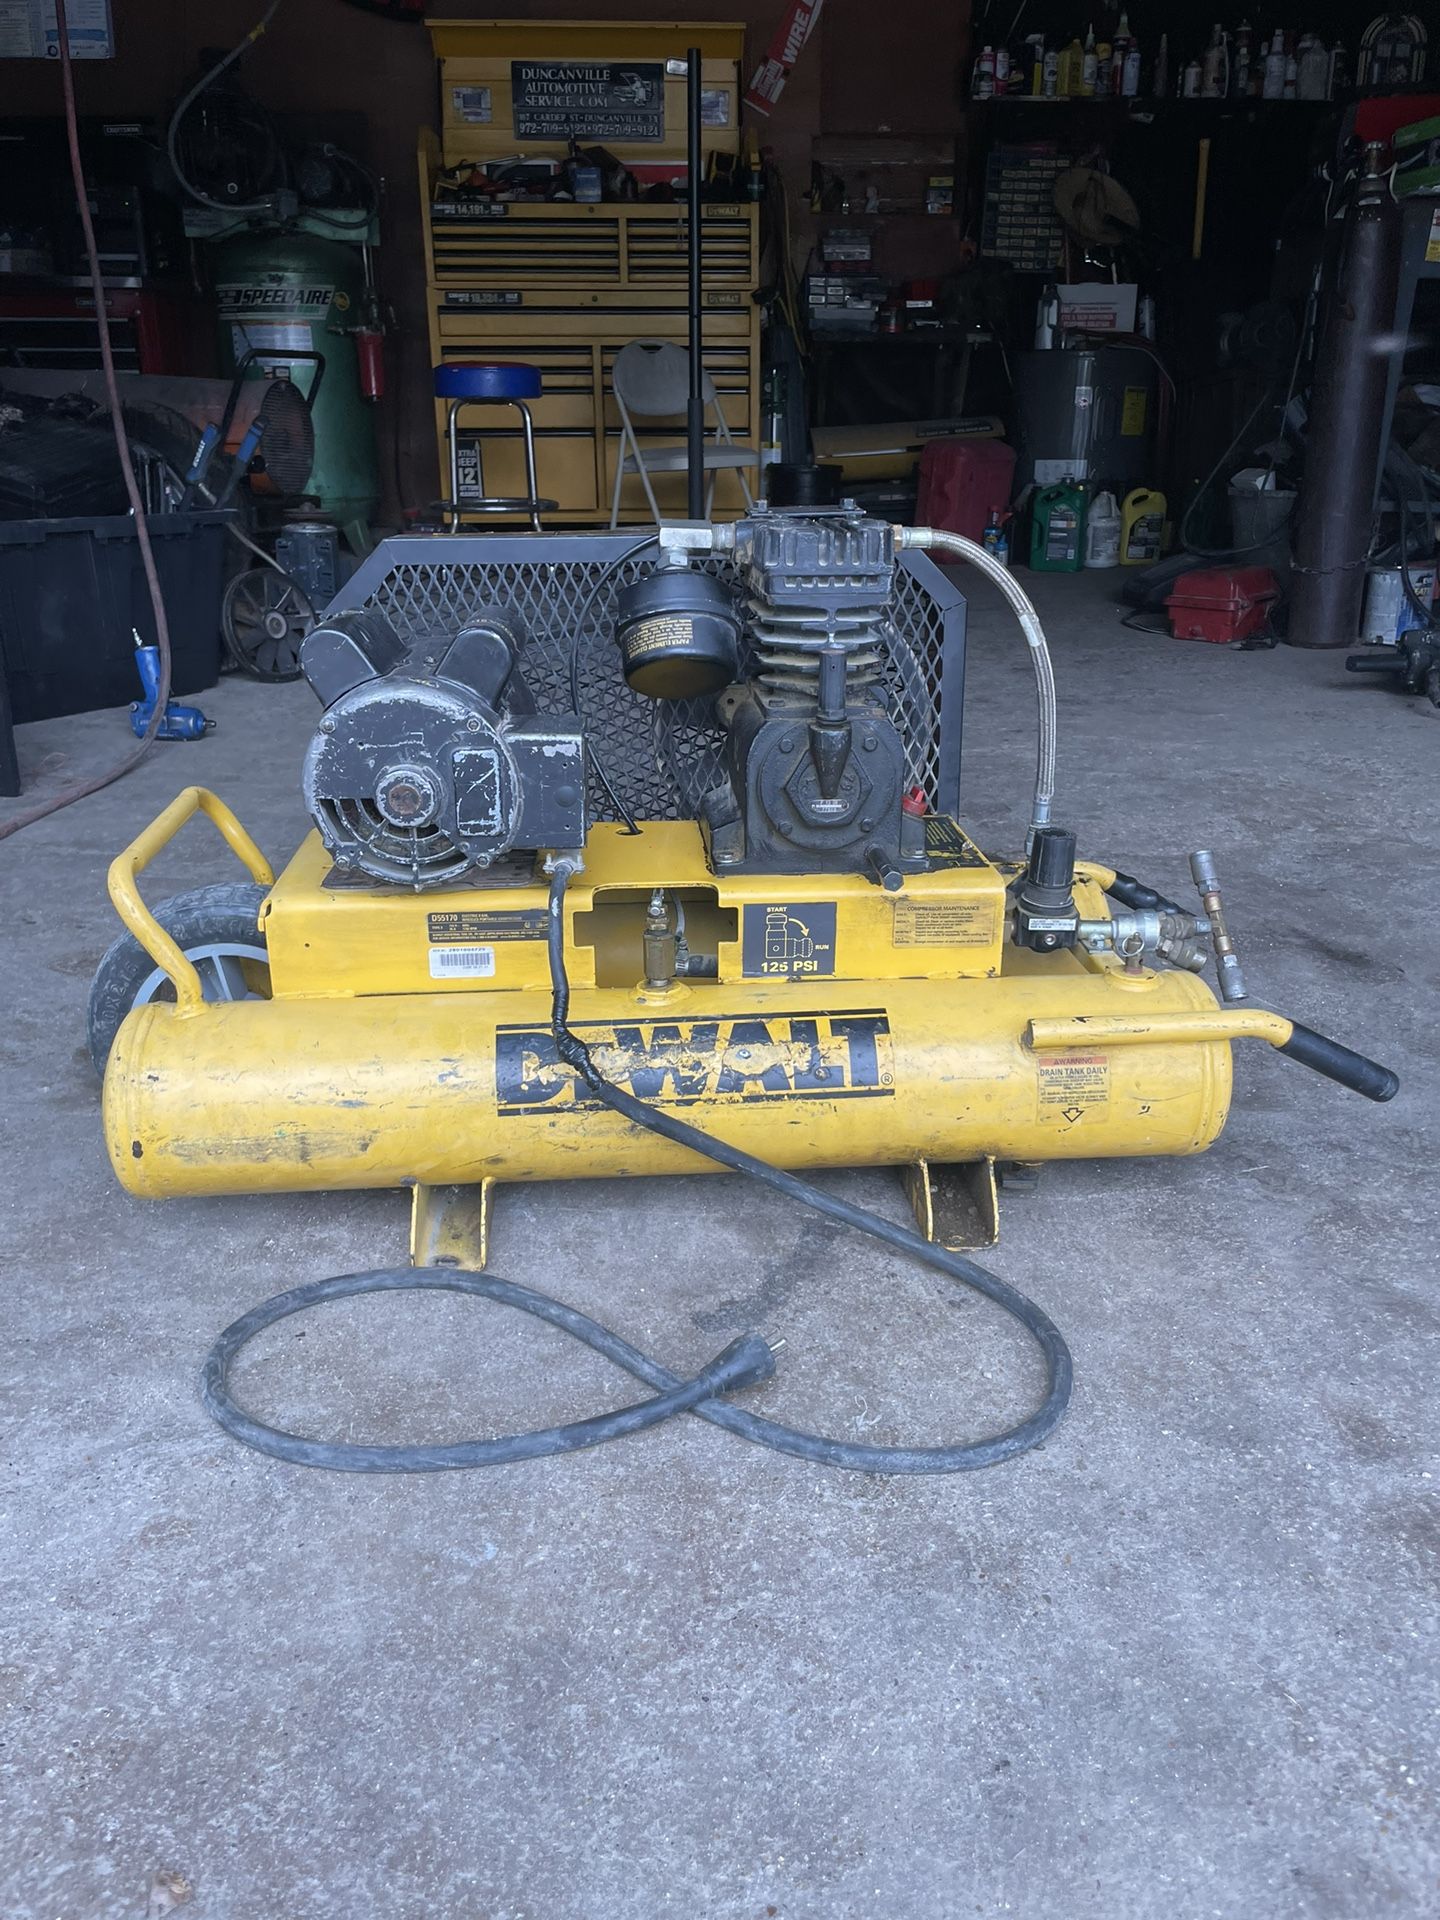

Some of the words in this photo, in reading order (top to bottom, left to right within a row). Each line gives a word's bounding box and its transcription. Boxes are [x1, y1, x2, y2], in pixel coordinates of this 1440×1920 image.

[781, 8, 810, 63] WIRE
[521, 68, 611, 80] DUNCANVILLE
[525, 81, 606, 94] AUTOMOTIVE
[458, 449, 477, 457] XTRA
[431, 914, 458, 922] D55170
[761, 961, 789, 973] 125
[793, 960, 818, 972] PSI
[1039, 1067, 1062, 1076] DRAIN
[1062, 1066, 1083, 1074] TANK
[1083, 1065, 1107, 1074] DAILY
